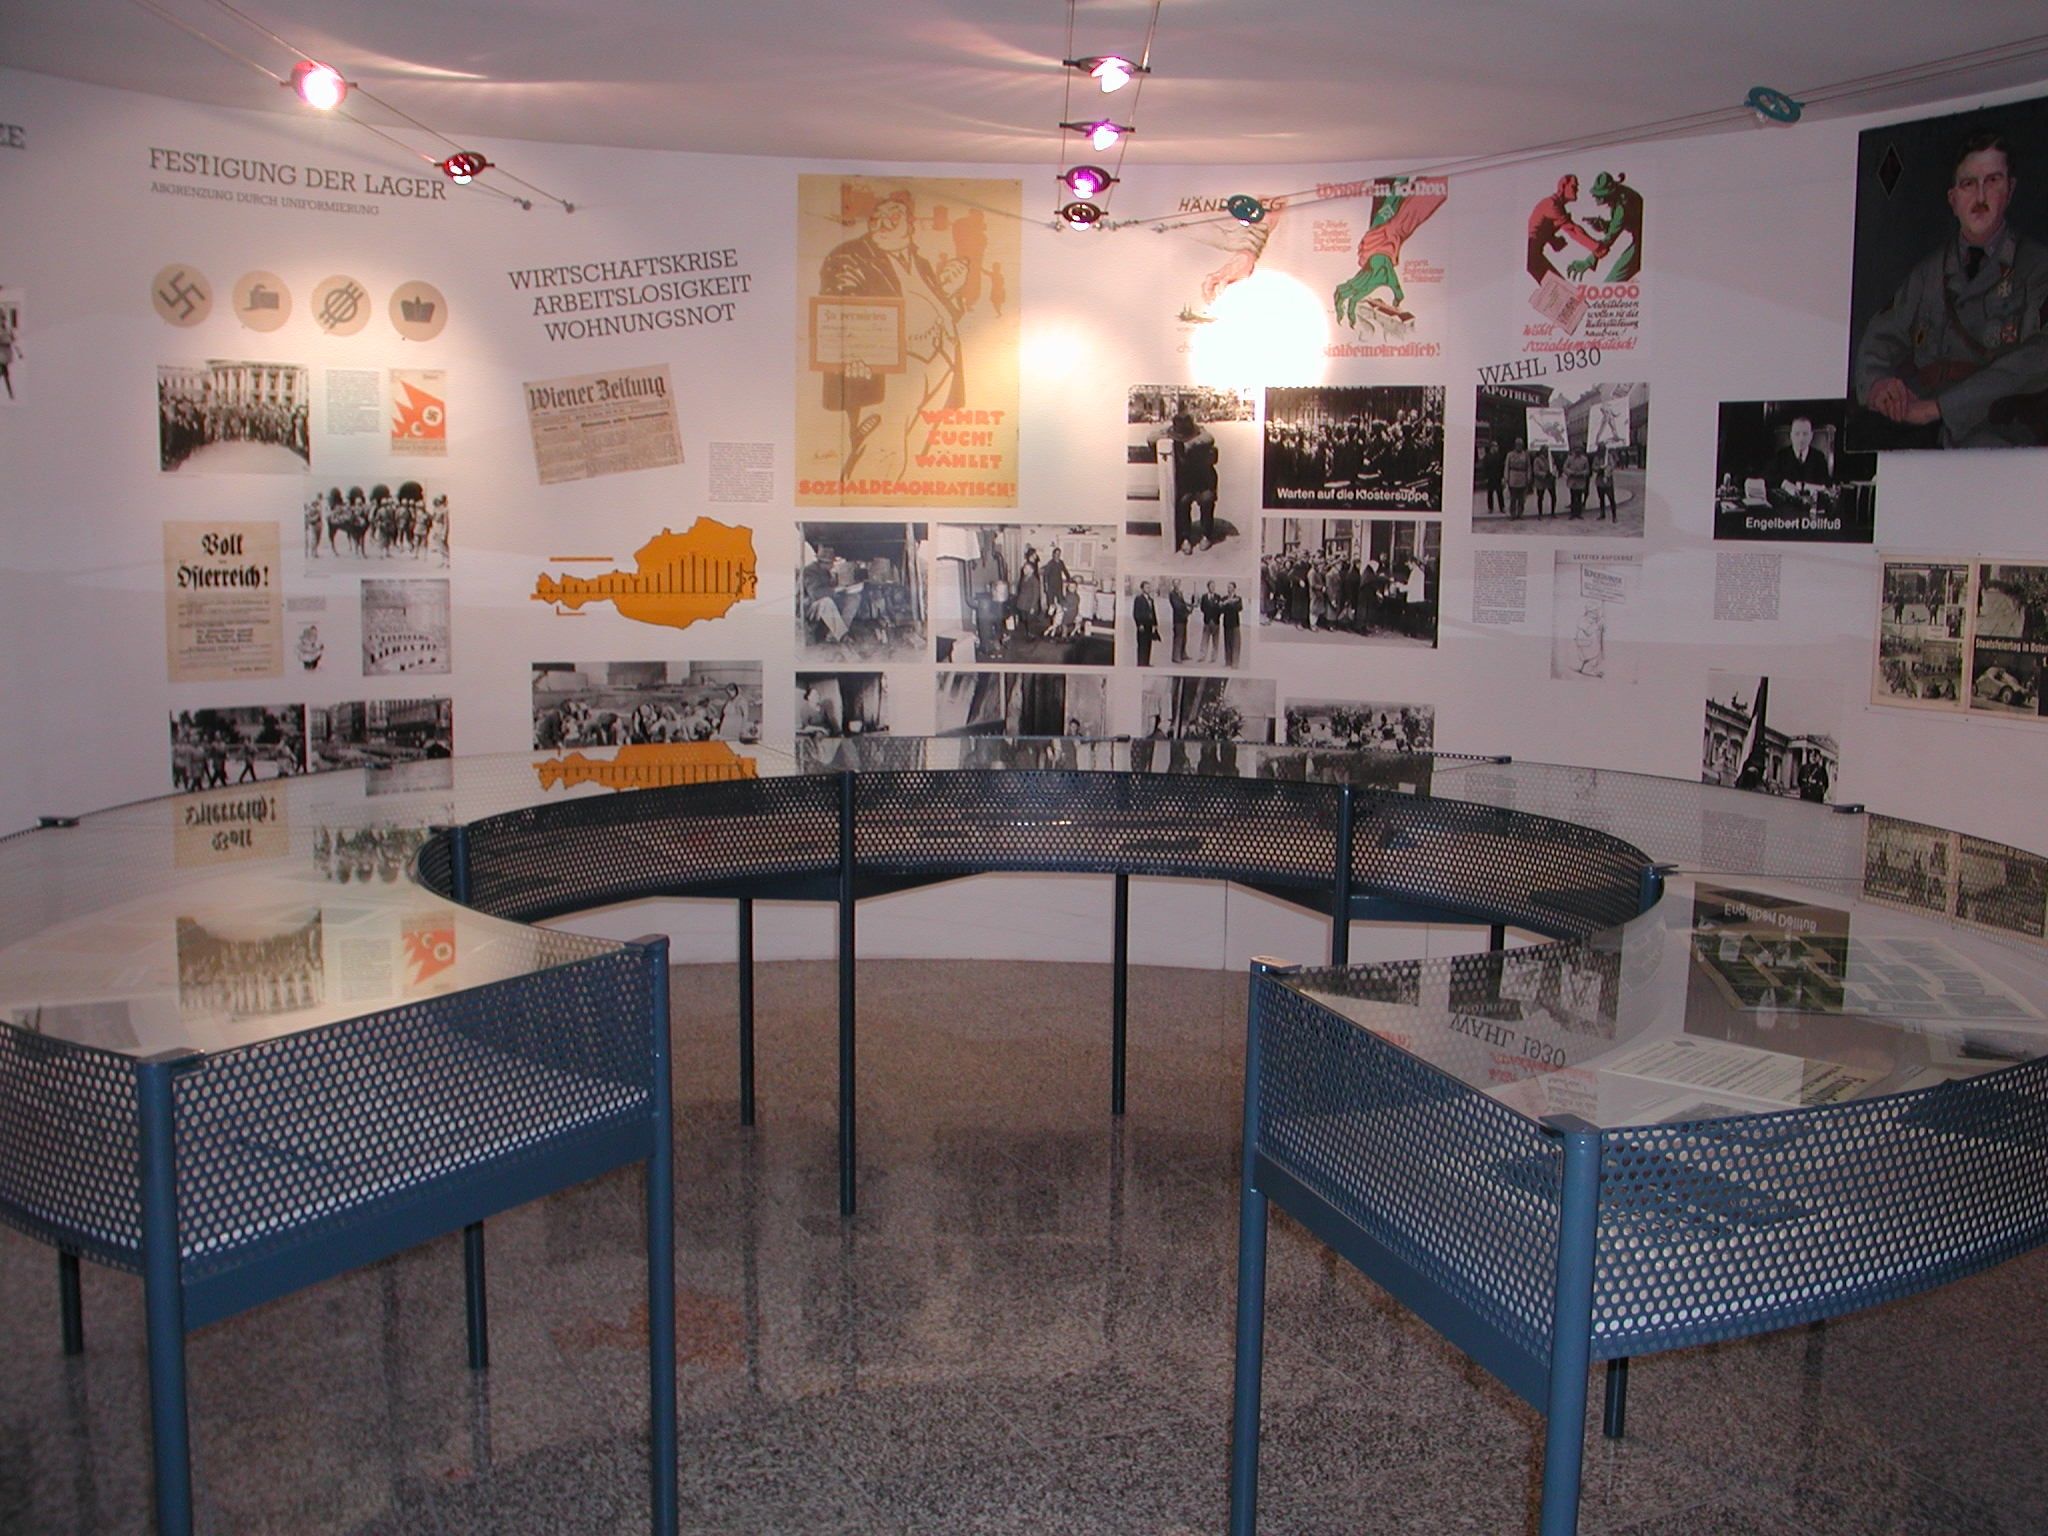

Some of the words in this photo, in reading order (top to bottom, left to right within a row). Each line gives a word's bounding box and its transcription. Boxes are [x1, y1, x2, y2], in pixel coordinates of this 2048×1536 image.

[149, 147, 297, 186] FESTIGUNG
[304, 167, 356, 192] DER
[364, 173, 446, 200] LAGER
[151, 181, 233, 201] ABGRENZUNG
[236, 191, 279, 206] DURCH
[281, 197, 379, 215] UNIFORMIERUNG
[1178, 195, 1229, 213] HÄND
[507, 248, 738, 290] WIRTSCHAFTSKRISE
[532, 274, 752, 316] ARBEITSLOSIGKEIT
[544, 302, 736, 341] WOHNUNGSNOT
[1477, 357, 1547, 385] WAHL
[1555, 347, 1601, 373] 1930
[529, 385, 594, 411] Wiener
[595, 375, 667, 401] Zeitung
[1481, 384, 1541, 405] APOTHEKE
[919, 410, 1005, 426] WEHRT
[927, 430, 994, 447] EUCH!
[798, 479, 1017, 498] SOZIALDEMOKRATISCH!
[1277, 488, 1315, 499] Warten
[1317, 488, 1335, 500] auf
[1336, 488, 1354, 500] die
[1355, 488, 1429, 502] Klostersuppe
[1745, 517, 1800, 531] Engelbert
[1801, 517, 1842, 530] Dollfuß
